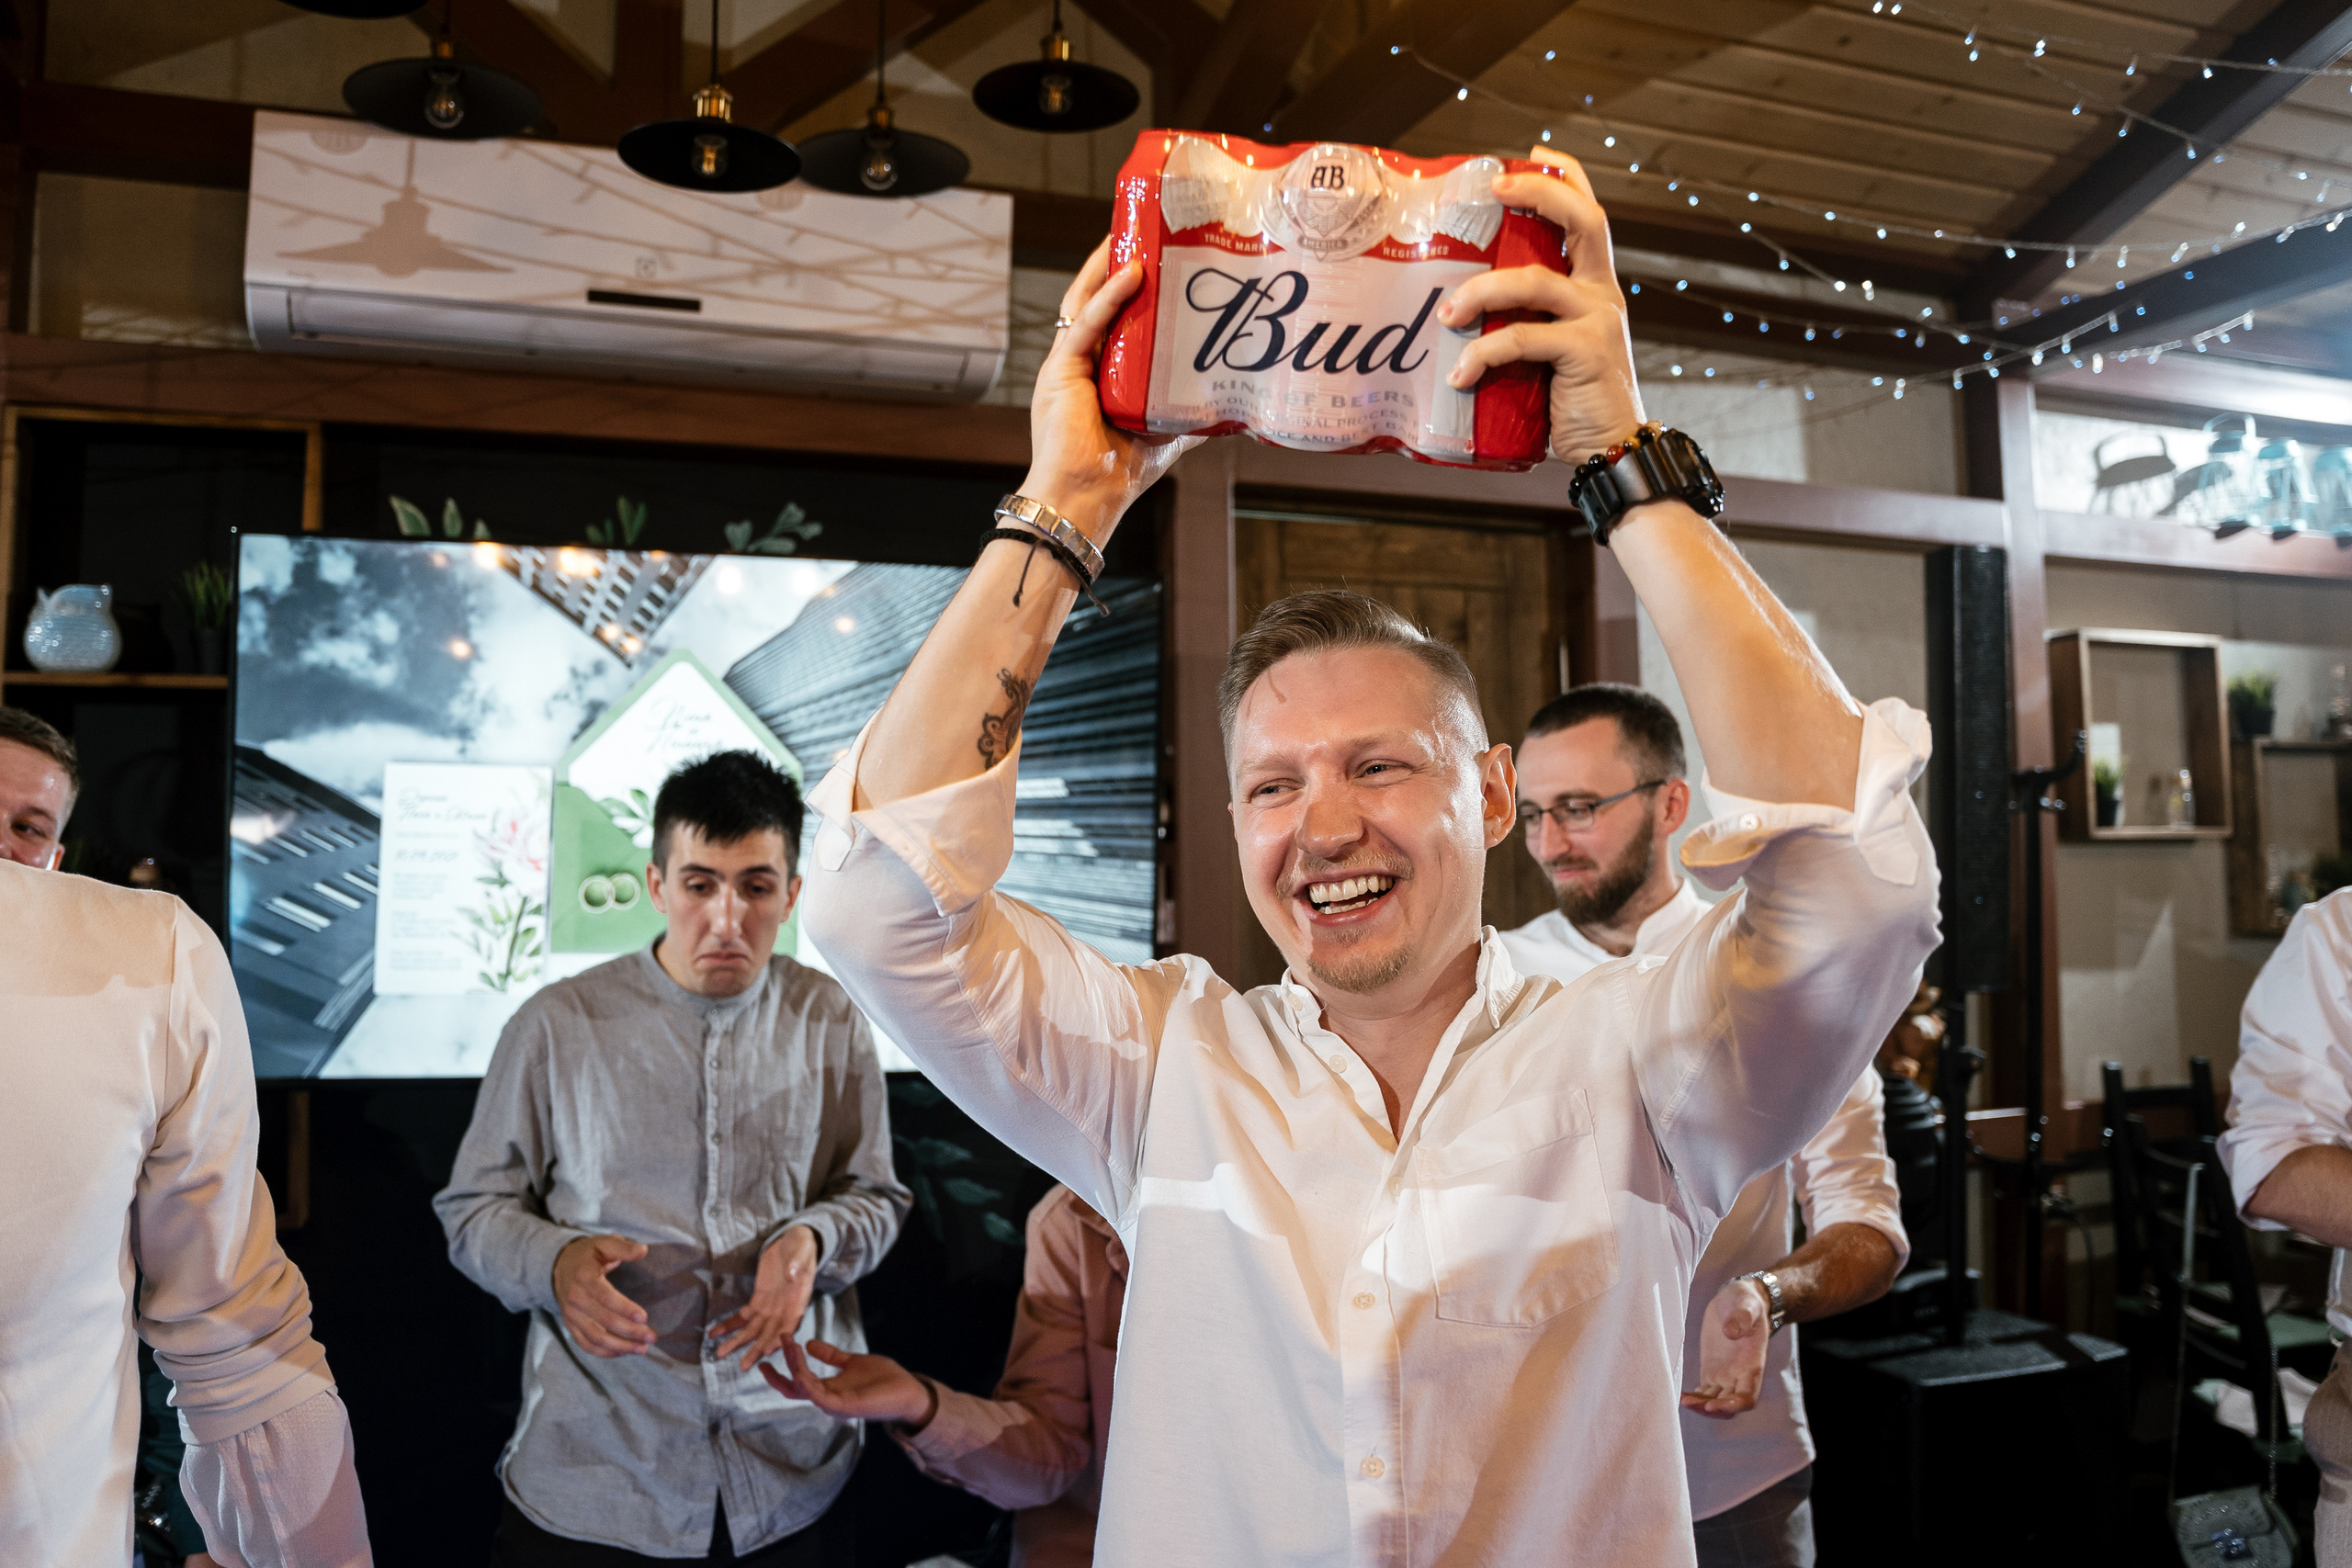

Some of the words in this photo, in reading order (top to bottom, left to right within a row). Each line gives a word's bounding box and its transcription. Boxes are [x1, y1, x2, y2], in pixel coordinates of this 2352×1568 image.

[1310, 164, 1345, 190] AB
[1204, 233, 1232, 249] TRADE
[1302, 237, 1344, 251] AMERICA
[1185, 267, 1444, 375] Bud
[1212, 379, 1271, 398] KING
[1281, 390, 1318, 409] OF
[1331, 390, 1415, 409] BEERS
[1227, 397, 1259, 414] OUR
[1337, 409, 1408, 428] PROCESS
[1265, 425, 1294, 440] ICE
[1301, 434, 1336, 445] AND
